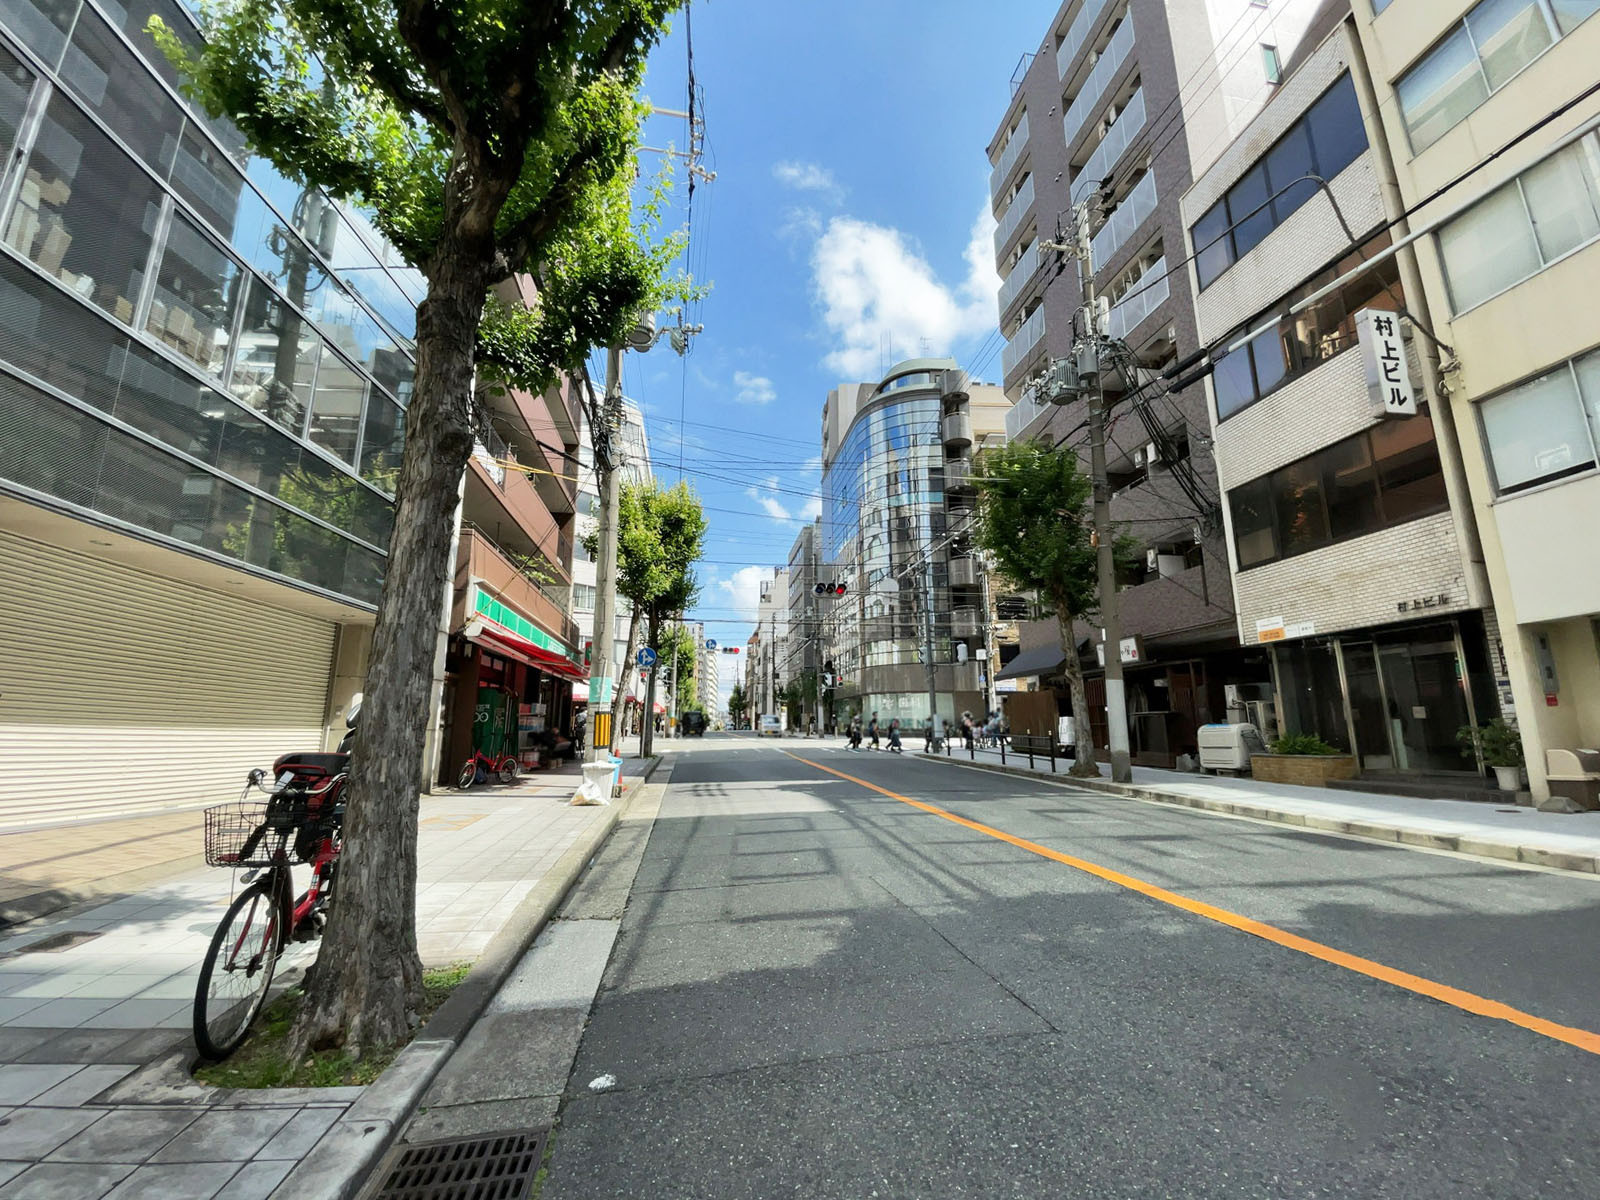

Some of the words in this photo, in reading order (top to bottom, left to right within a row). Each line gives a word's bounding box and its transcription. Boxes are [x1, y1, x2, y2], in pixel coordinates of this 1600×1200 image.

[1374, 316, 1407, 406] 村上ビル
[1397, 594, 1450, 613] 村上ビル
